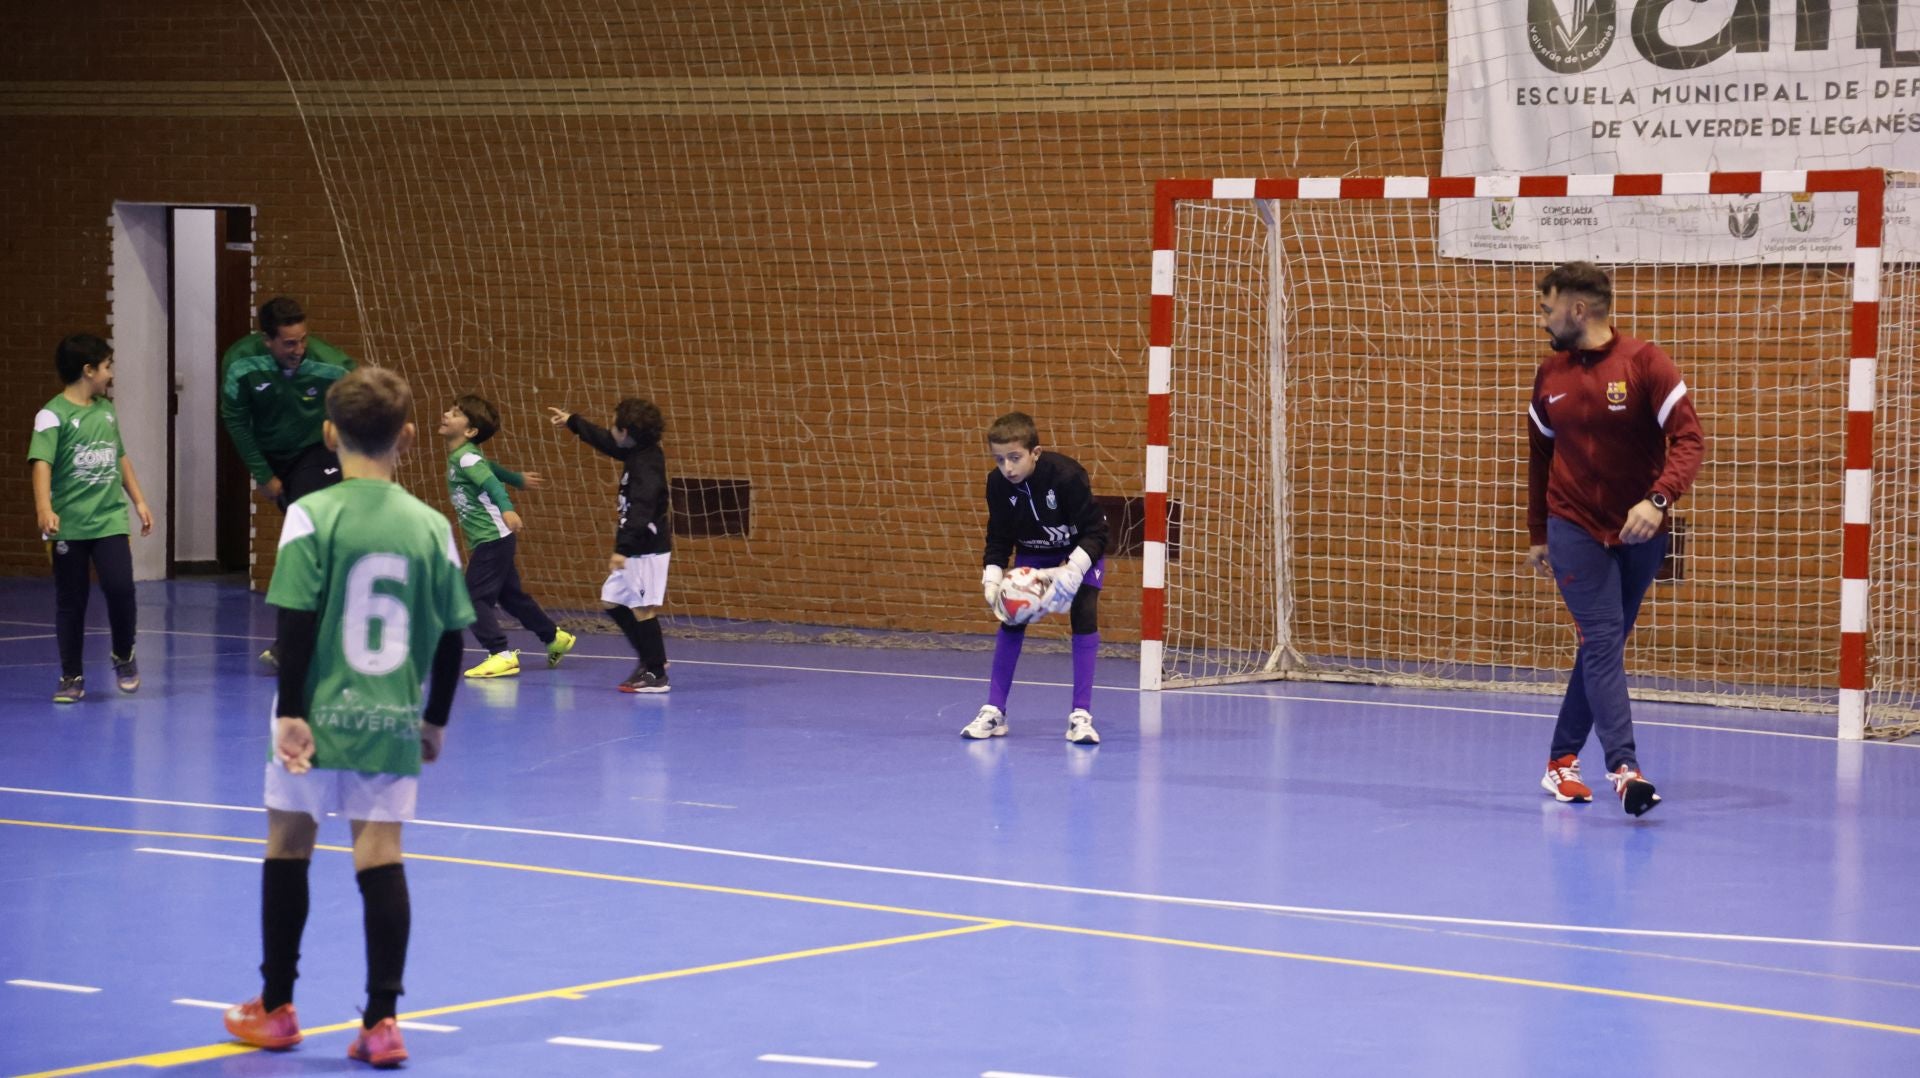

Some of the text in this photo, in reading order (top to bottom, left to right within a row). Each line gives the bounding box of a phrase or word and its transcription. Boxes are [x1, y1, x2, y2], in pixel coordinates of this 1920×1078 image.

[1530, 25, 1562, 62] Valverde
[1564, 53, 1578, 63] de
[1580, 24, 1615, 61] Leganés
[1516, 86, 1636, 106] ESCUELA
[1652, 82, 1809, 105] MUNICIPAL
[1825, 80, 1859, 100] DE
[1591, 108, 1920, 139] DE VALVERDE DE LEGANÉS
[1541, 217, 1599, 227] DE DEPORTES
[342, 553, 410, 675] 6
